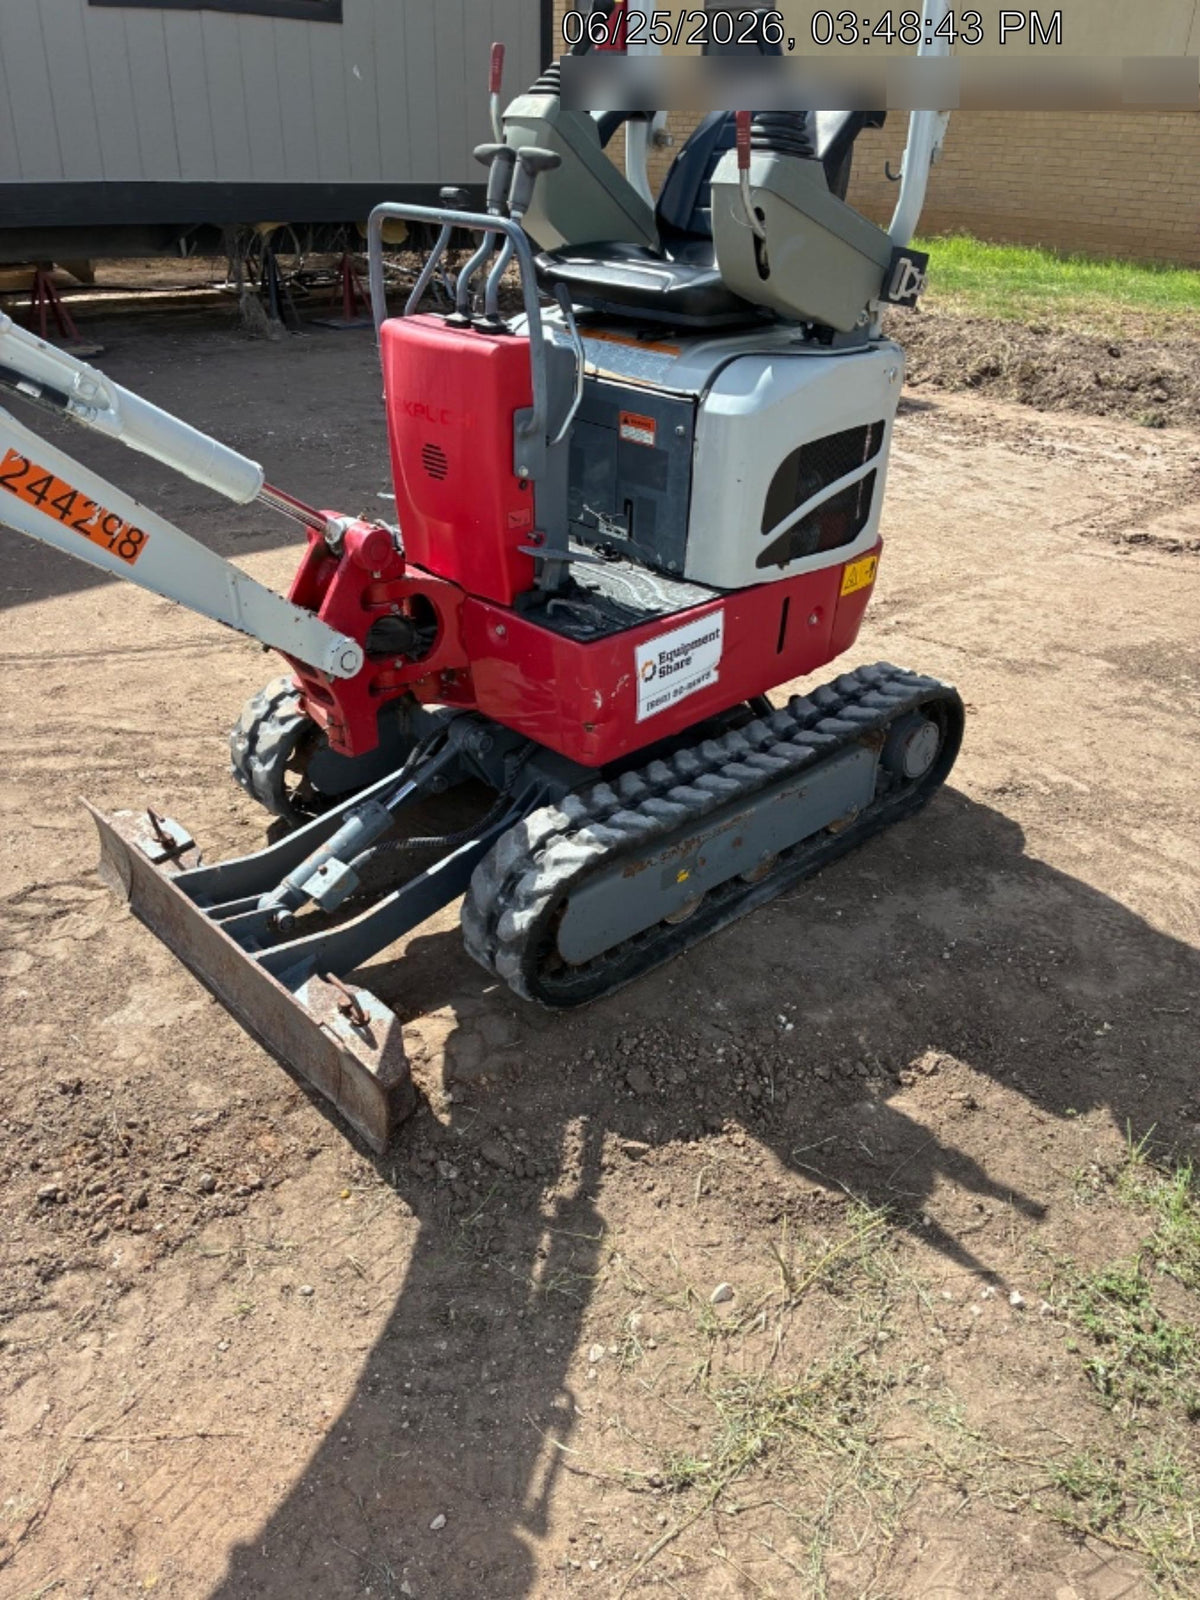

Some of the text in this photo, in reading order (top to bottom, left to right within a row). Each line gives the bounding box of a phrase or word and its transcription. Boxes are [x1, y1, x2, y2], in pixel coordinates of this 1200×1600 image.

[0, 454, 145, 559] 244298
[658, 628, 721, 665] Equipment
[658, 656, 692, 678] Share
